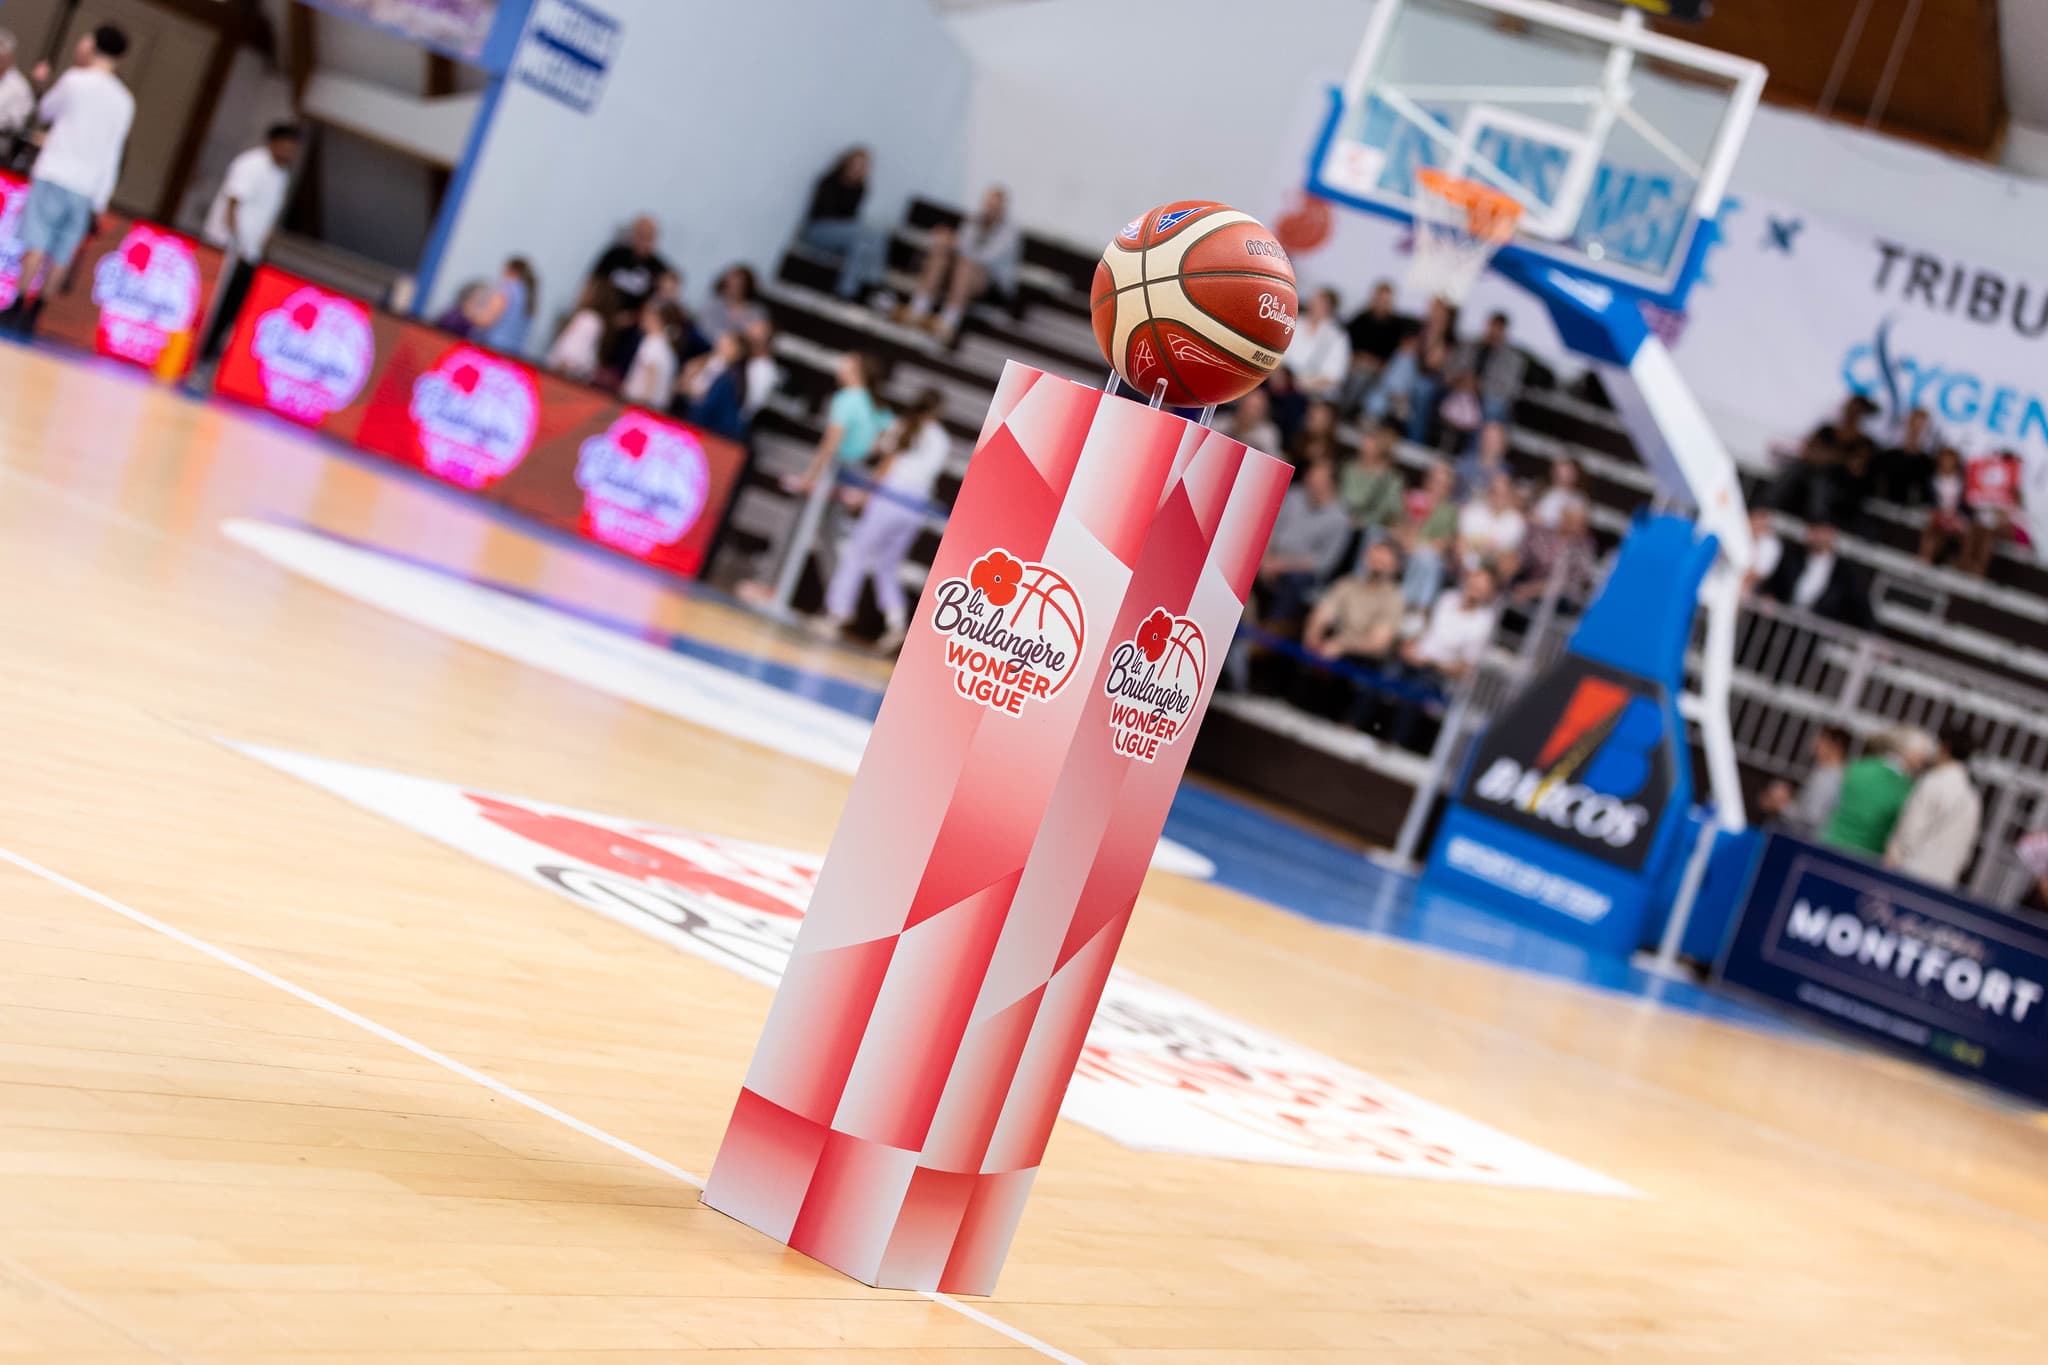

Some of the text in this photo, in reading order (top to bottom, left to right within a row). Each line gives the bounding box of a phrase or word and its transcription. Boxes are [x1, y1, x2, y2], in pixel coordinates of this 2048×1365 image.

[1258, 293, 1296, 335] Boulang
[934, 580, 1065, 674] la Boulangère
[948, 641, 1051, 699] WONDER
[957, 671, 1025, 714] LIGUE
[1106, 643, 1190, 724] la Boulangère
[1112, 702, 1177, 741] WONDER
[1115, 729, 1159, 760] LIGUE
[1786, 897, 2044, 1023] MONTFORT
